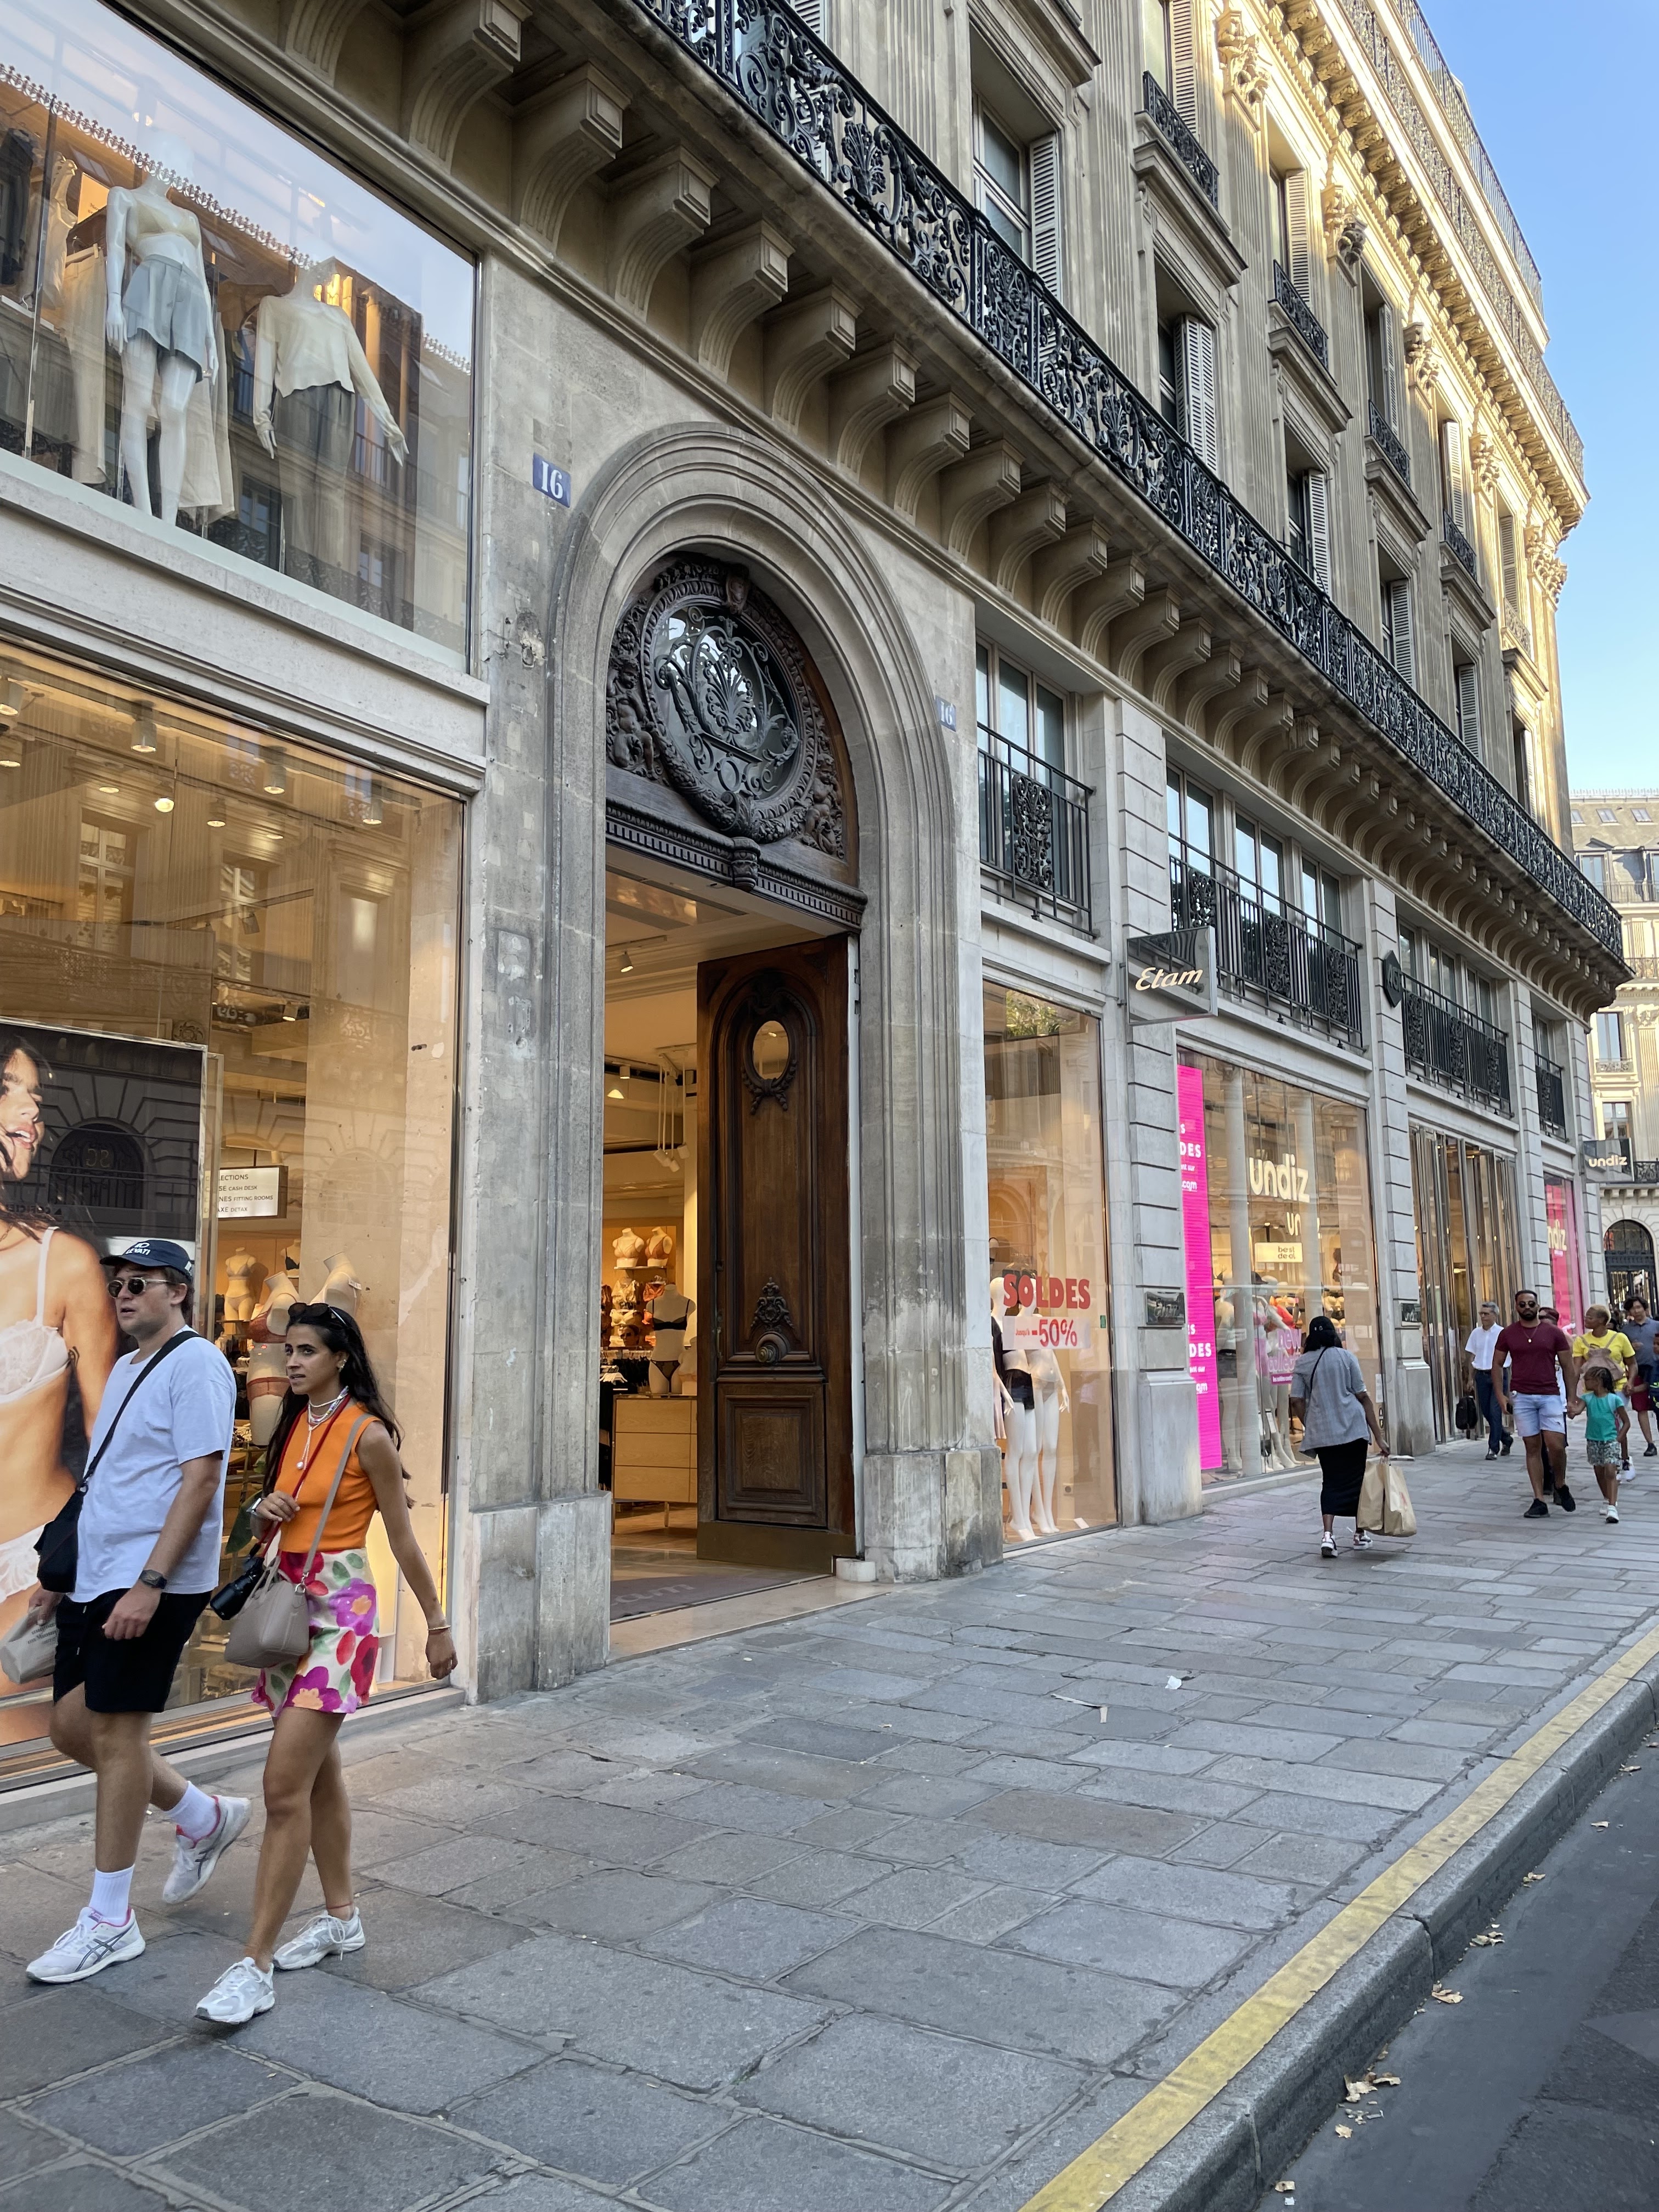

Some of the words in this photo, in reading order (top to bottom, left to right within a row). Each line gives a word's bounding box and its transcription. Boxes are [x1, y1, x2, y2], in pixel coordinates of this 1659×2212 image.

[541, 460, 563, 499] 16
[940, 701, 953, 725] 16
[1135, 967, 1203, 991] Etam
[1180, 1141, 1201, 1158] DES
[1588, 1154, 1628, 1167] undiz
[1181, 1180, 1198, 1192] .com
[1249, 1153, 1310, 1203] undiz
[1547, 1219, 1567, 1251] ndiz
[1003, 1273, 1091, 1310] SOLDES
[1031, 1318, 1078, 1347] -50%
[1277, 1328, 1302, 1350] new
[1189, 1342, 1212, 1358] DES
[611, 1583, 695, 1606] am
